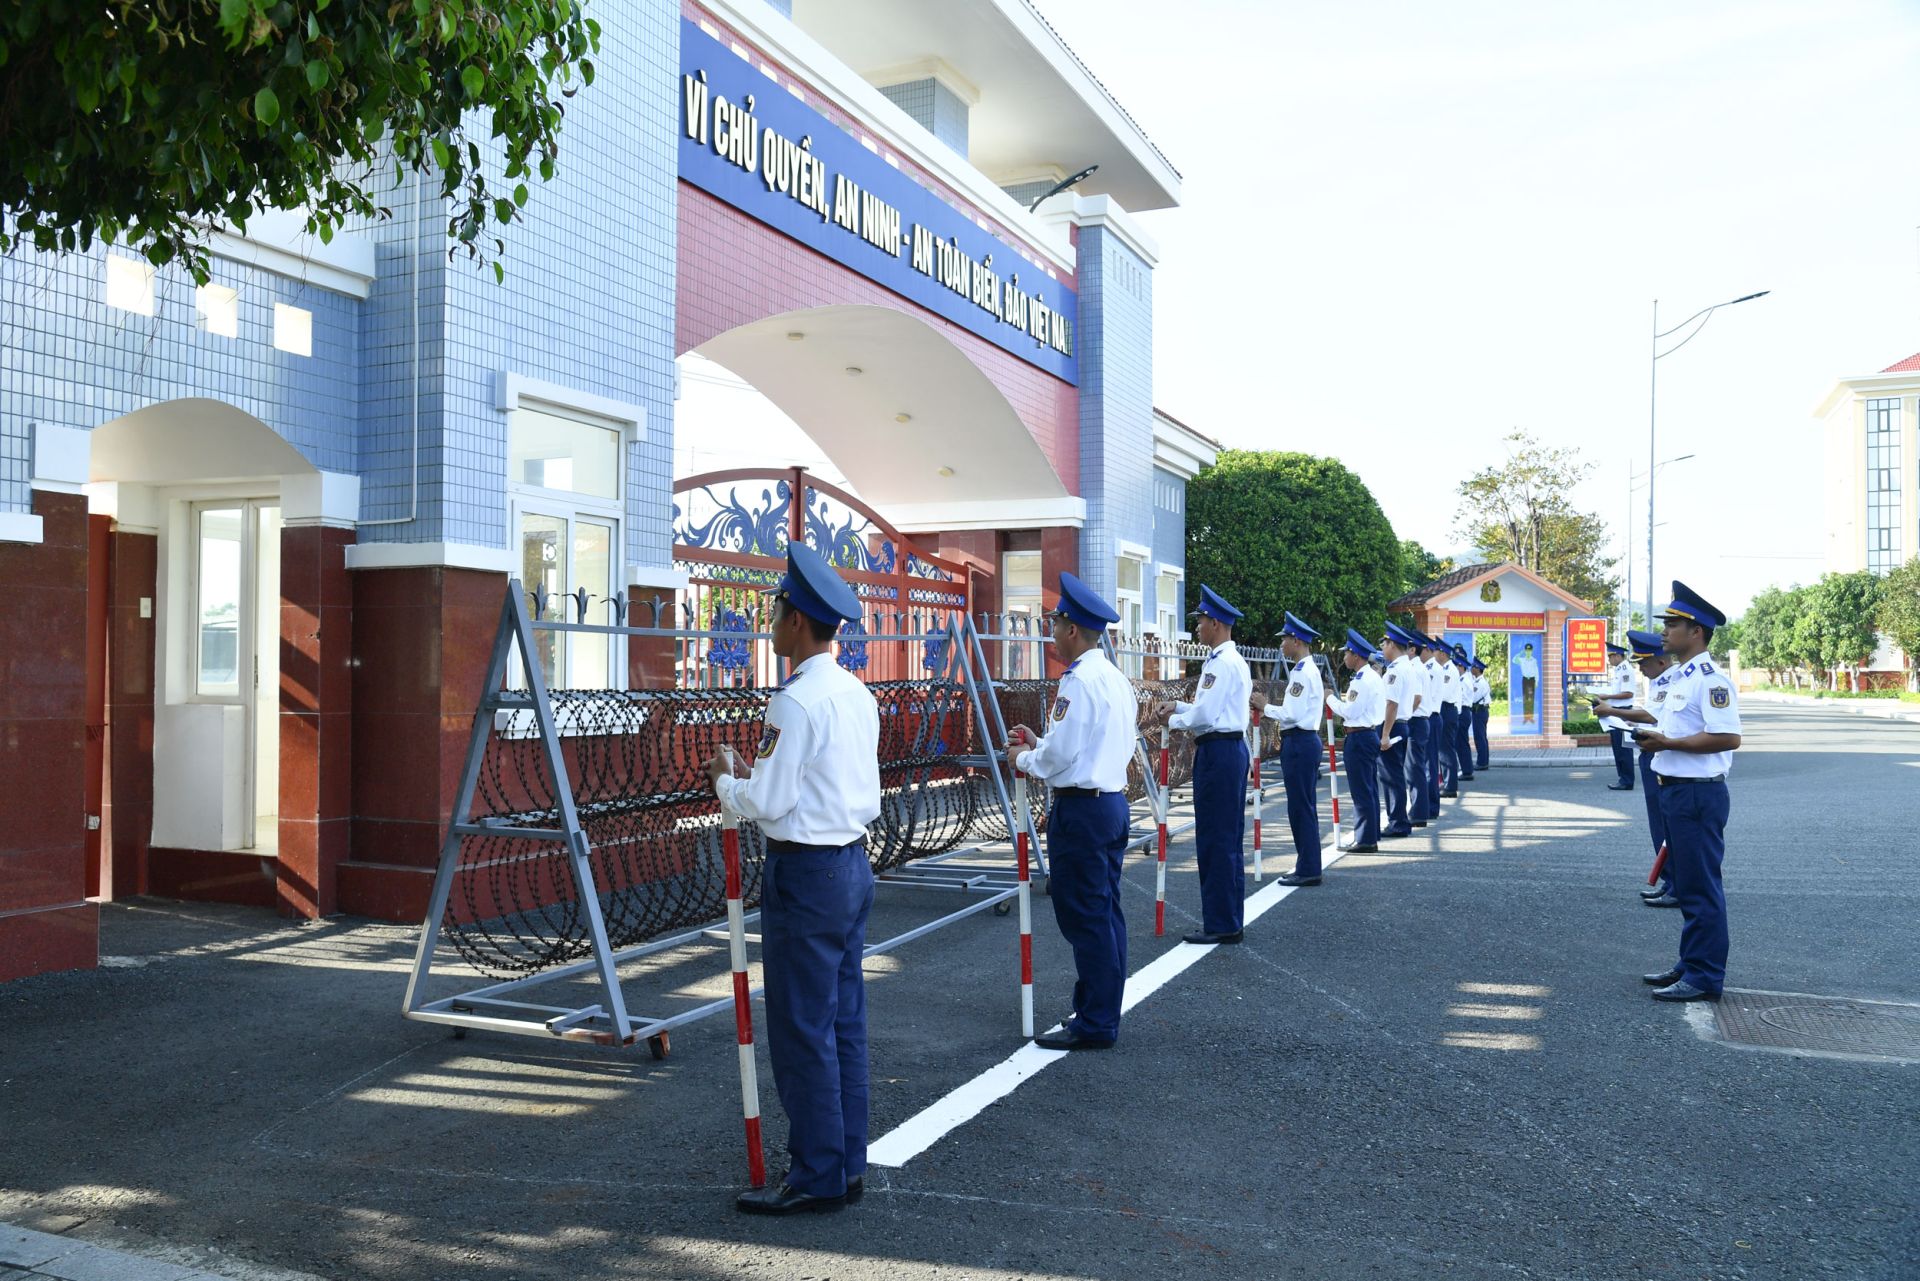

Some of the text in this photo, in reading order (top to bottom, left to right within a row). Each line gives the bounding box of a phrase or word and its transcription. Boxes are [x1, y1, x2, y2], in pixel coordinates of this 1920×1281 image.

[685, 69, 708, 145] VÌ
[714, 94, 758, 173] CHỦ
[762, 127, 830, 223] QUYỀN,
[834, 173, 859, 234] AN
[861, 189, 901, 258] NINH
[912, 223, 933, 277] AN
[935, 237, 970, 299] TOÀN
[972, 254, 1003, 323] BIỂN,
[1004, 272, 1027, 332] ĐẢO
[1028, 293, 1051, 349] VIỆT
